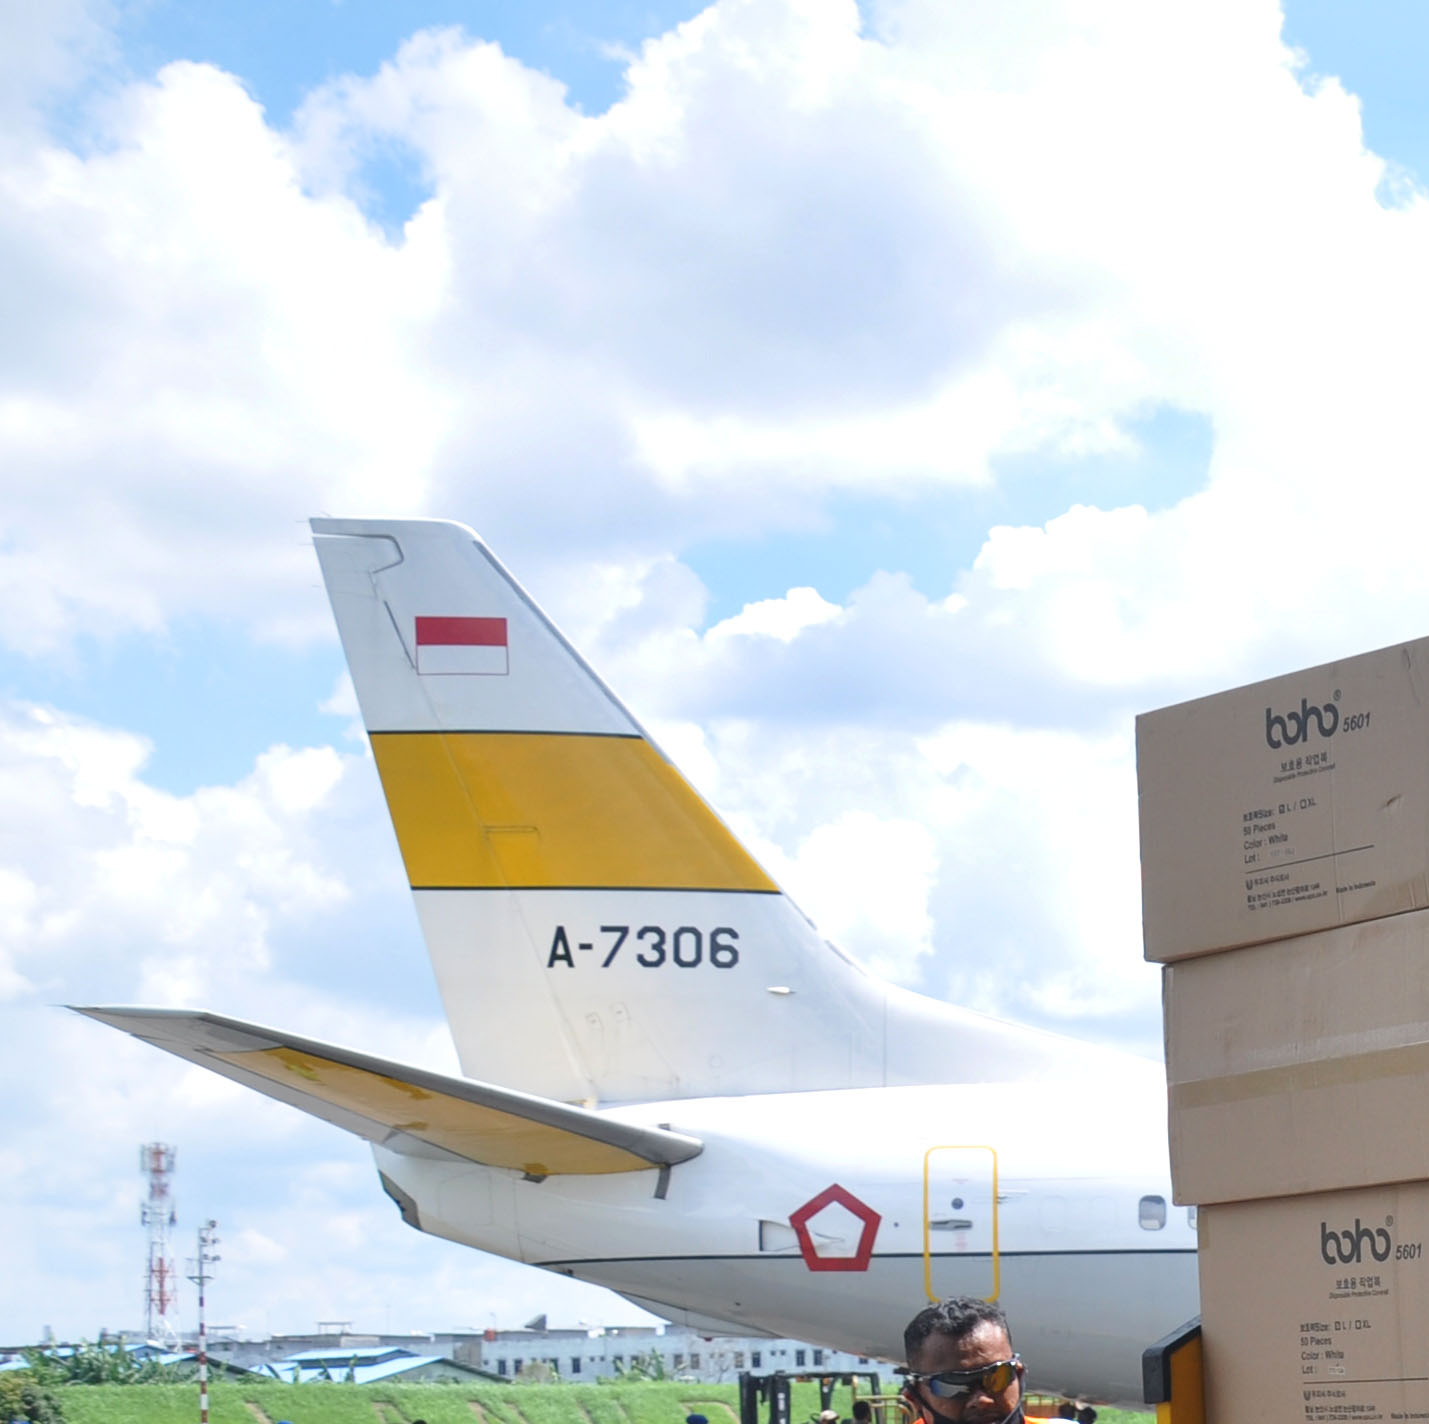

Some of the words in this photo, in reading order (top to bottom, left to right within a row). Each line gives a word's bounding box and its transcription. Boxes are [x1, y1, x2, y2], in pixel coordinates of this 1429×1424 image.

[1343, 712, 1371, 733] 5601
[547, 925, 740, 969] A-7306
[1396, 1243, 1422, 1260] 5601
